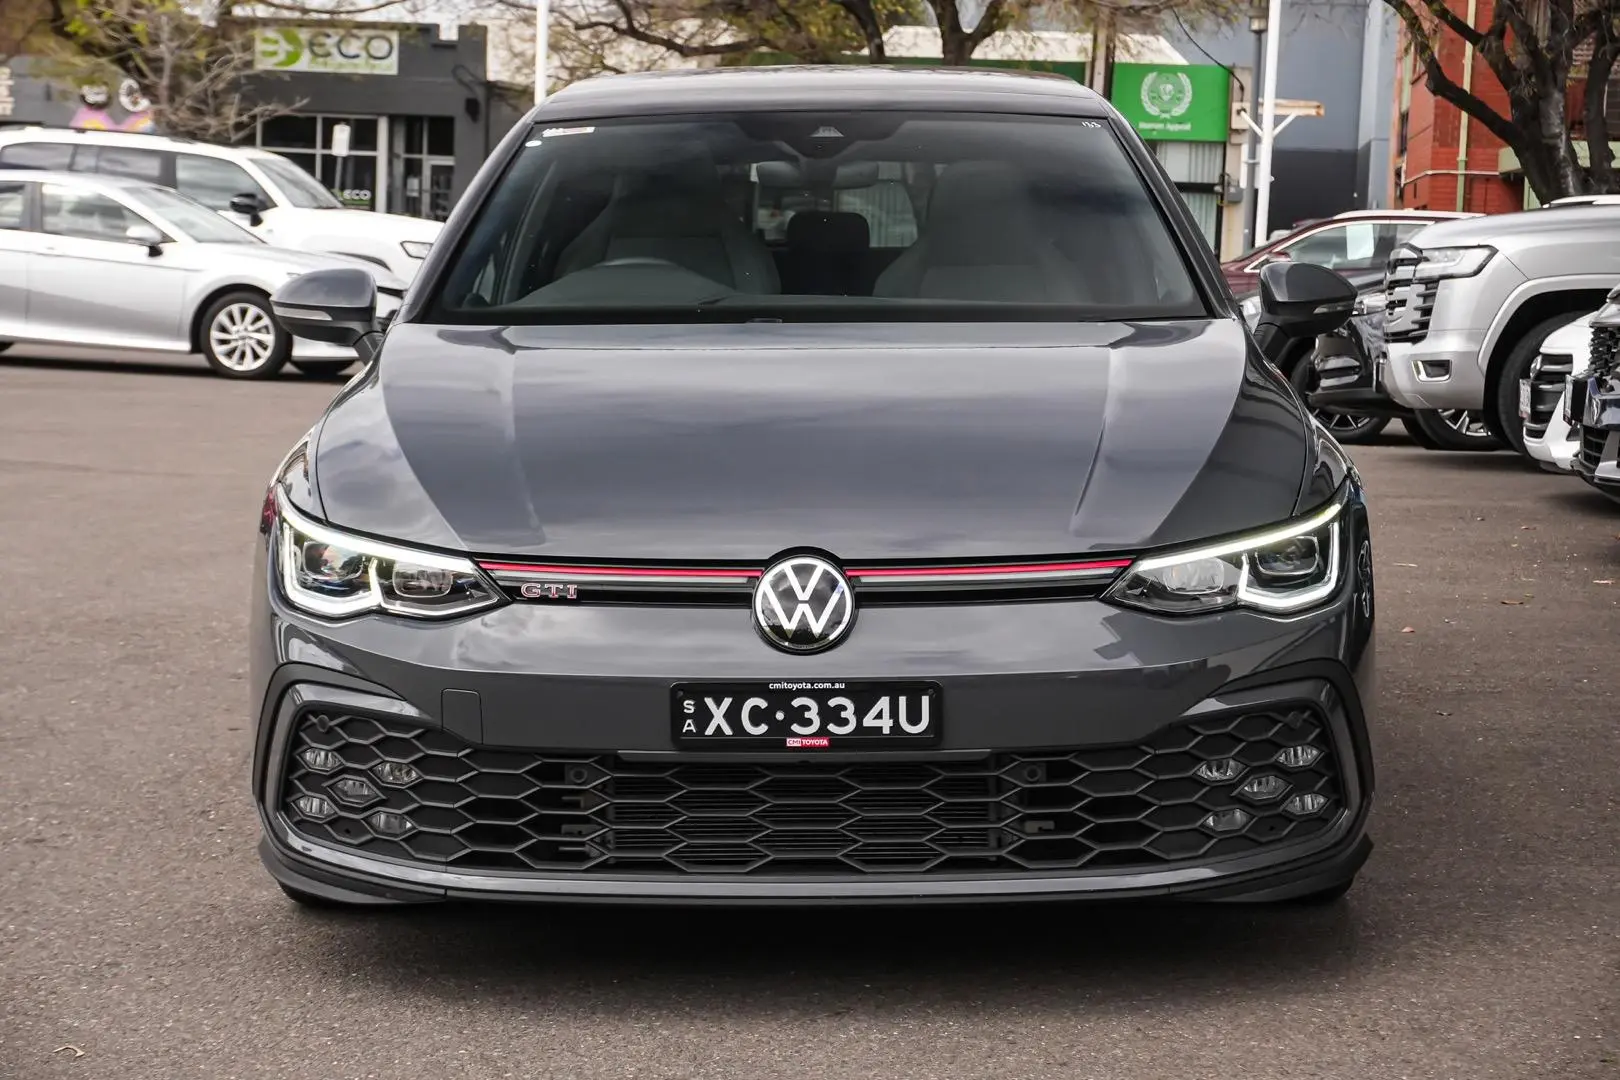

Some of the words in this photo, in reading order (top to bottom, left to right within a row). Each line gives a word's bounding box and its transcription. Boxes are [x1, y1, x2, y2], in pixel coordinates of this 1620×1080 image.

[520, 582, 578, 600] GTI
[768, 681, 846, 691] cmitoyota.com.au
[787, 738, 801, 746] CMI
[801, 738, 829, 746] TOYOTA
